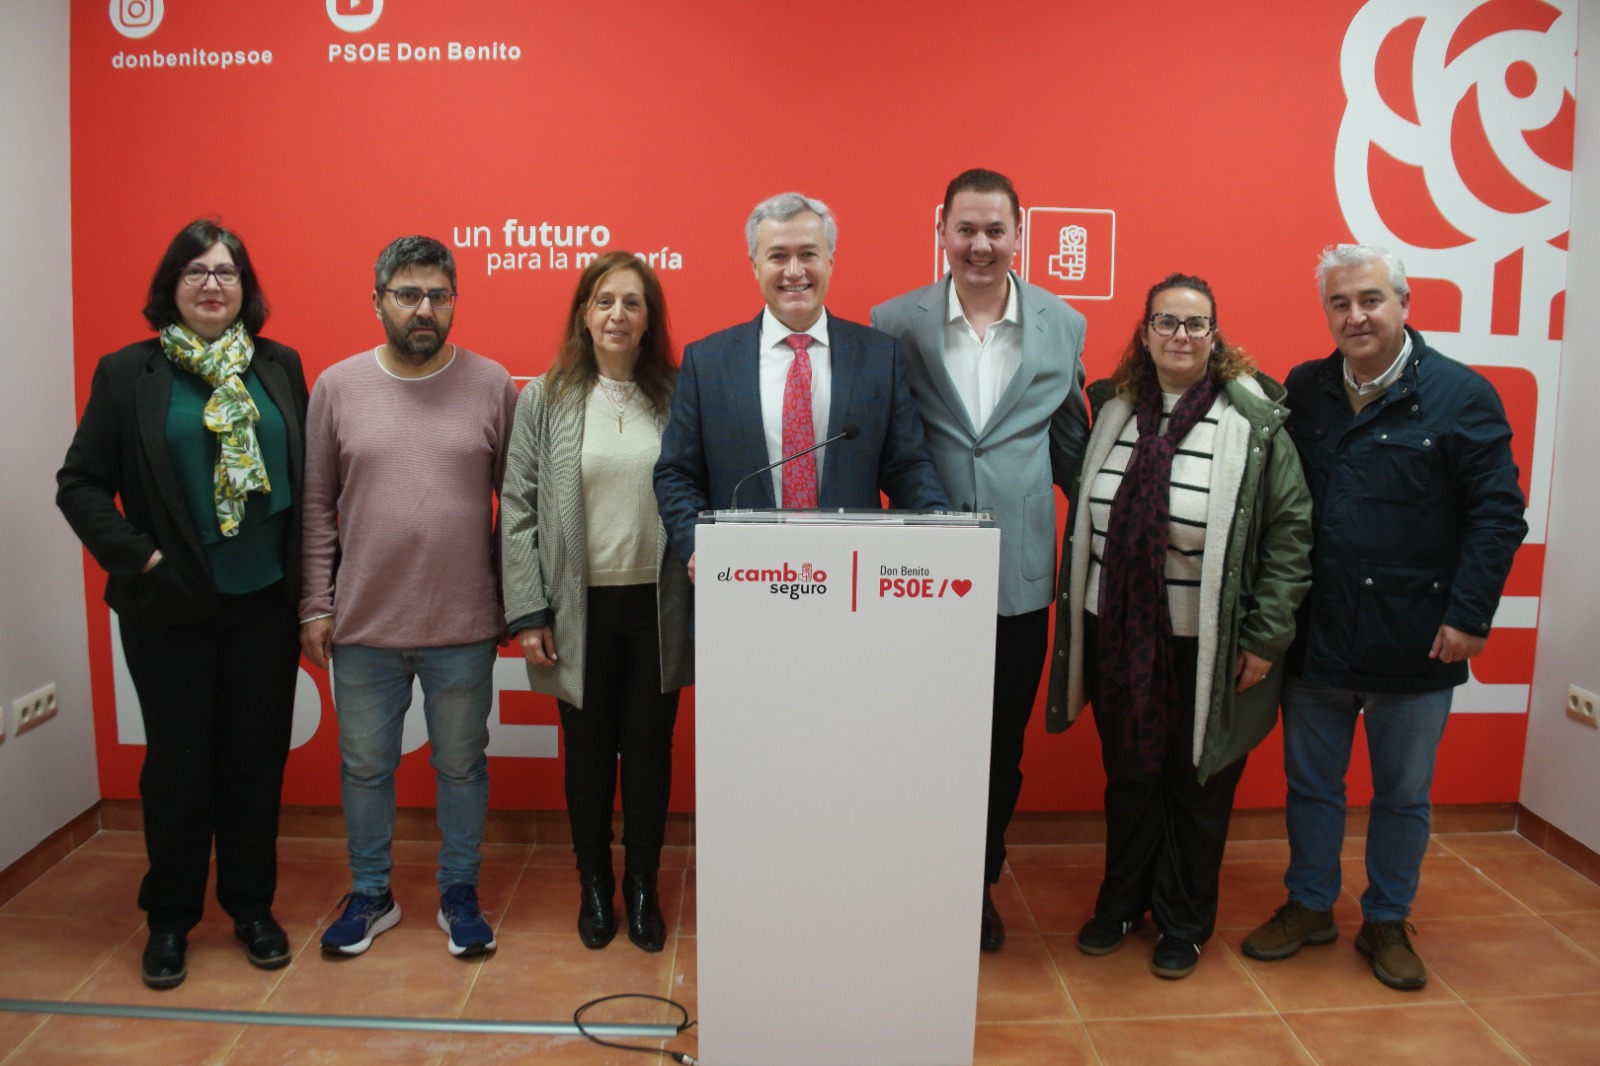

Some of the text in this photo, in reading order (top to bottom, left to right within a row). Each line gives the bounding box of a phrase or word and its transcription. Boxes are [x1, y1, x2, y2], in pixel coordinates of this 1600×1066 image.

[112, 48, 273, 69] donbenitopsoe
[328, 42, 522, 63] PSOE Don Benito
[453, 218, 611, 248] un futuro
[487, 251, 541, 276] para
[549, 247, 568, 269] la
[717, 567, 732, 582] el
[880, 565, 930, 577] Don Benito
[770, 583, 827, 600] seguro
[879, 578, 934, 598] PSOE
